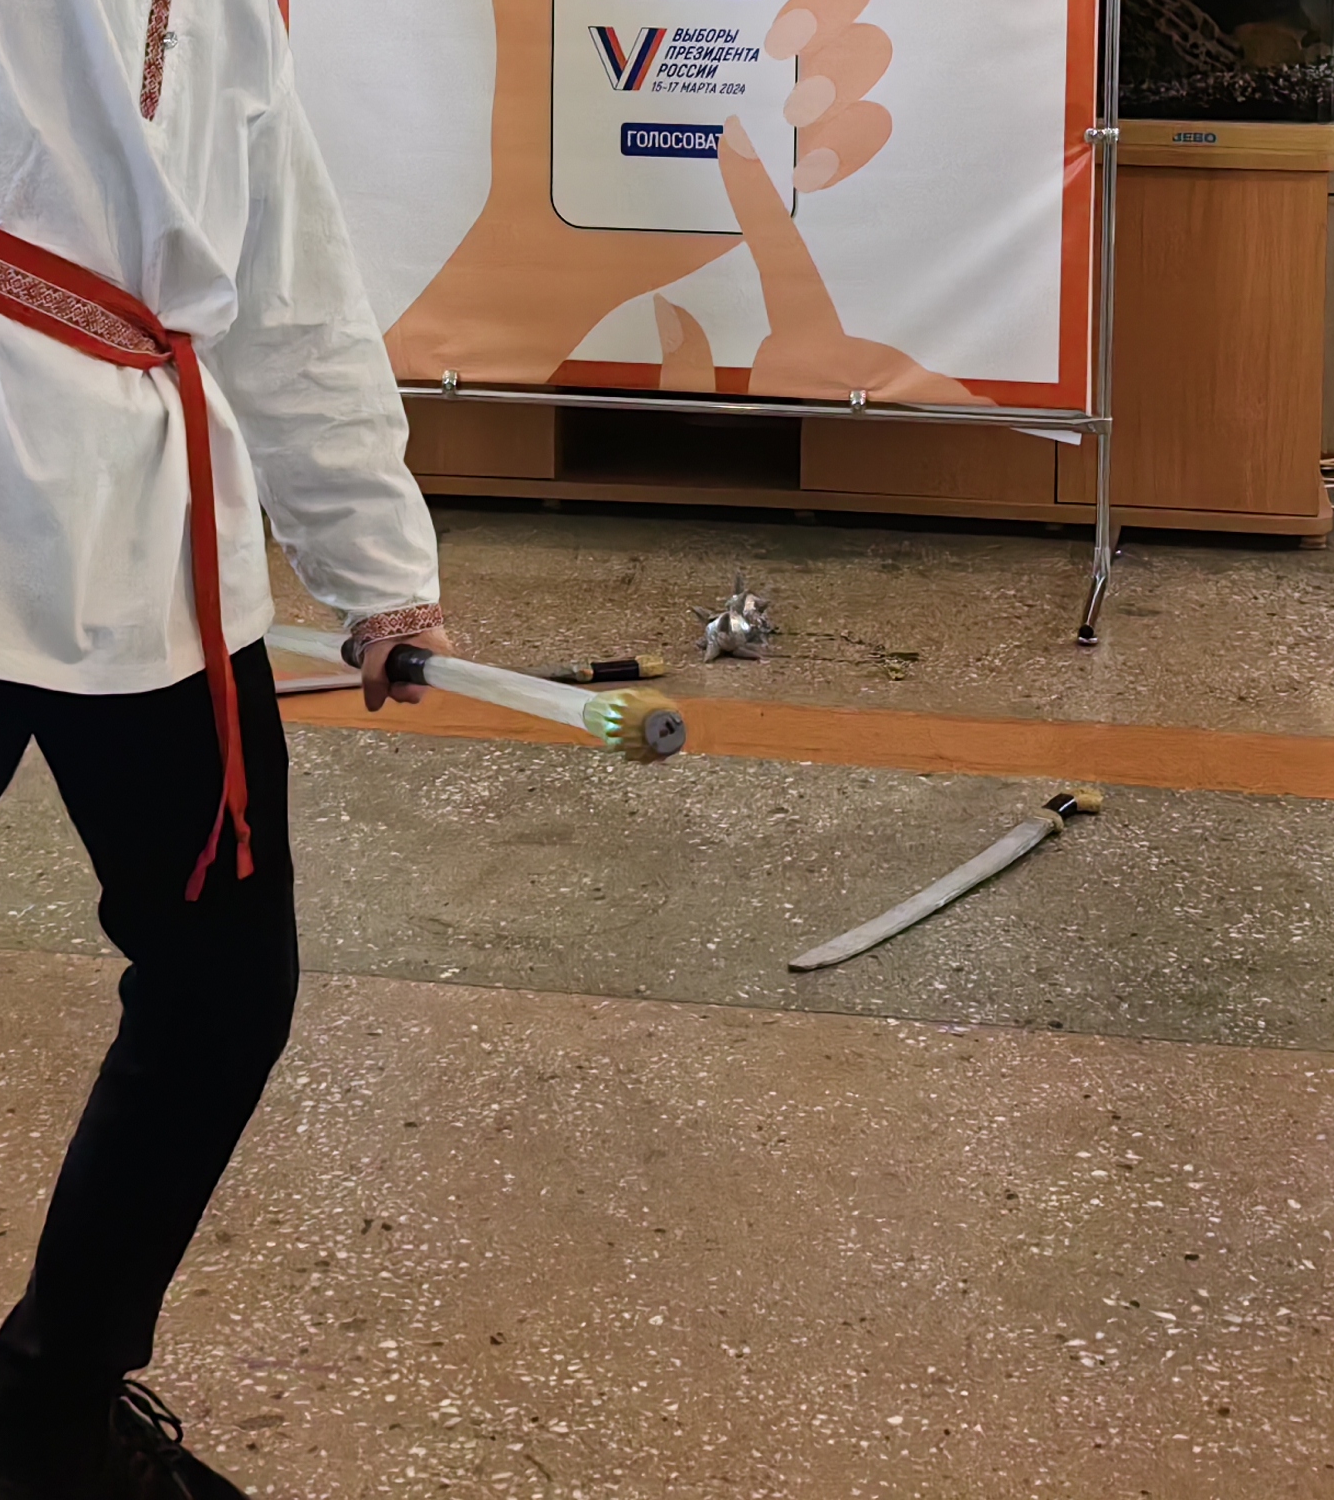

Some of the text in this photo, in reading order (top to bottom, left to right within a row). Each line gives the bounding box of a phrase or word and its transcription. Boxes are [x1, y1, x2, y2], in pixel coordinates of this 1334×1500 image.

[671, 27, 740, 44] ВЫБОРЫ
[664, 45, 760, 63] ПРЕЗИДЕНТА
[656, 62, 719, 79] РОССИИ
[651, 80, 746, 96] 15-17 МАРТА 2024
